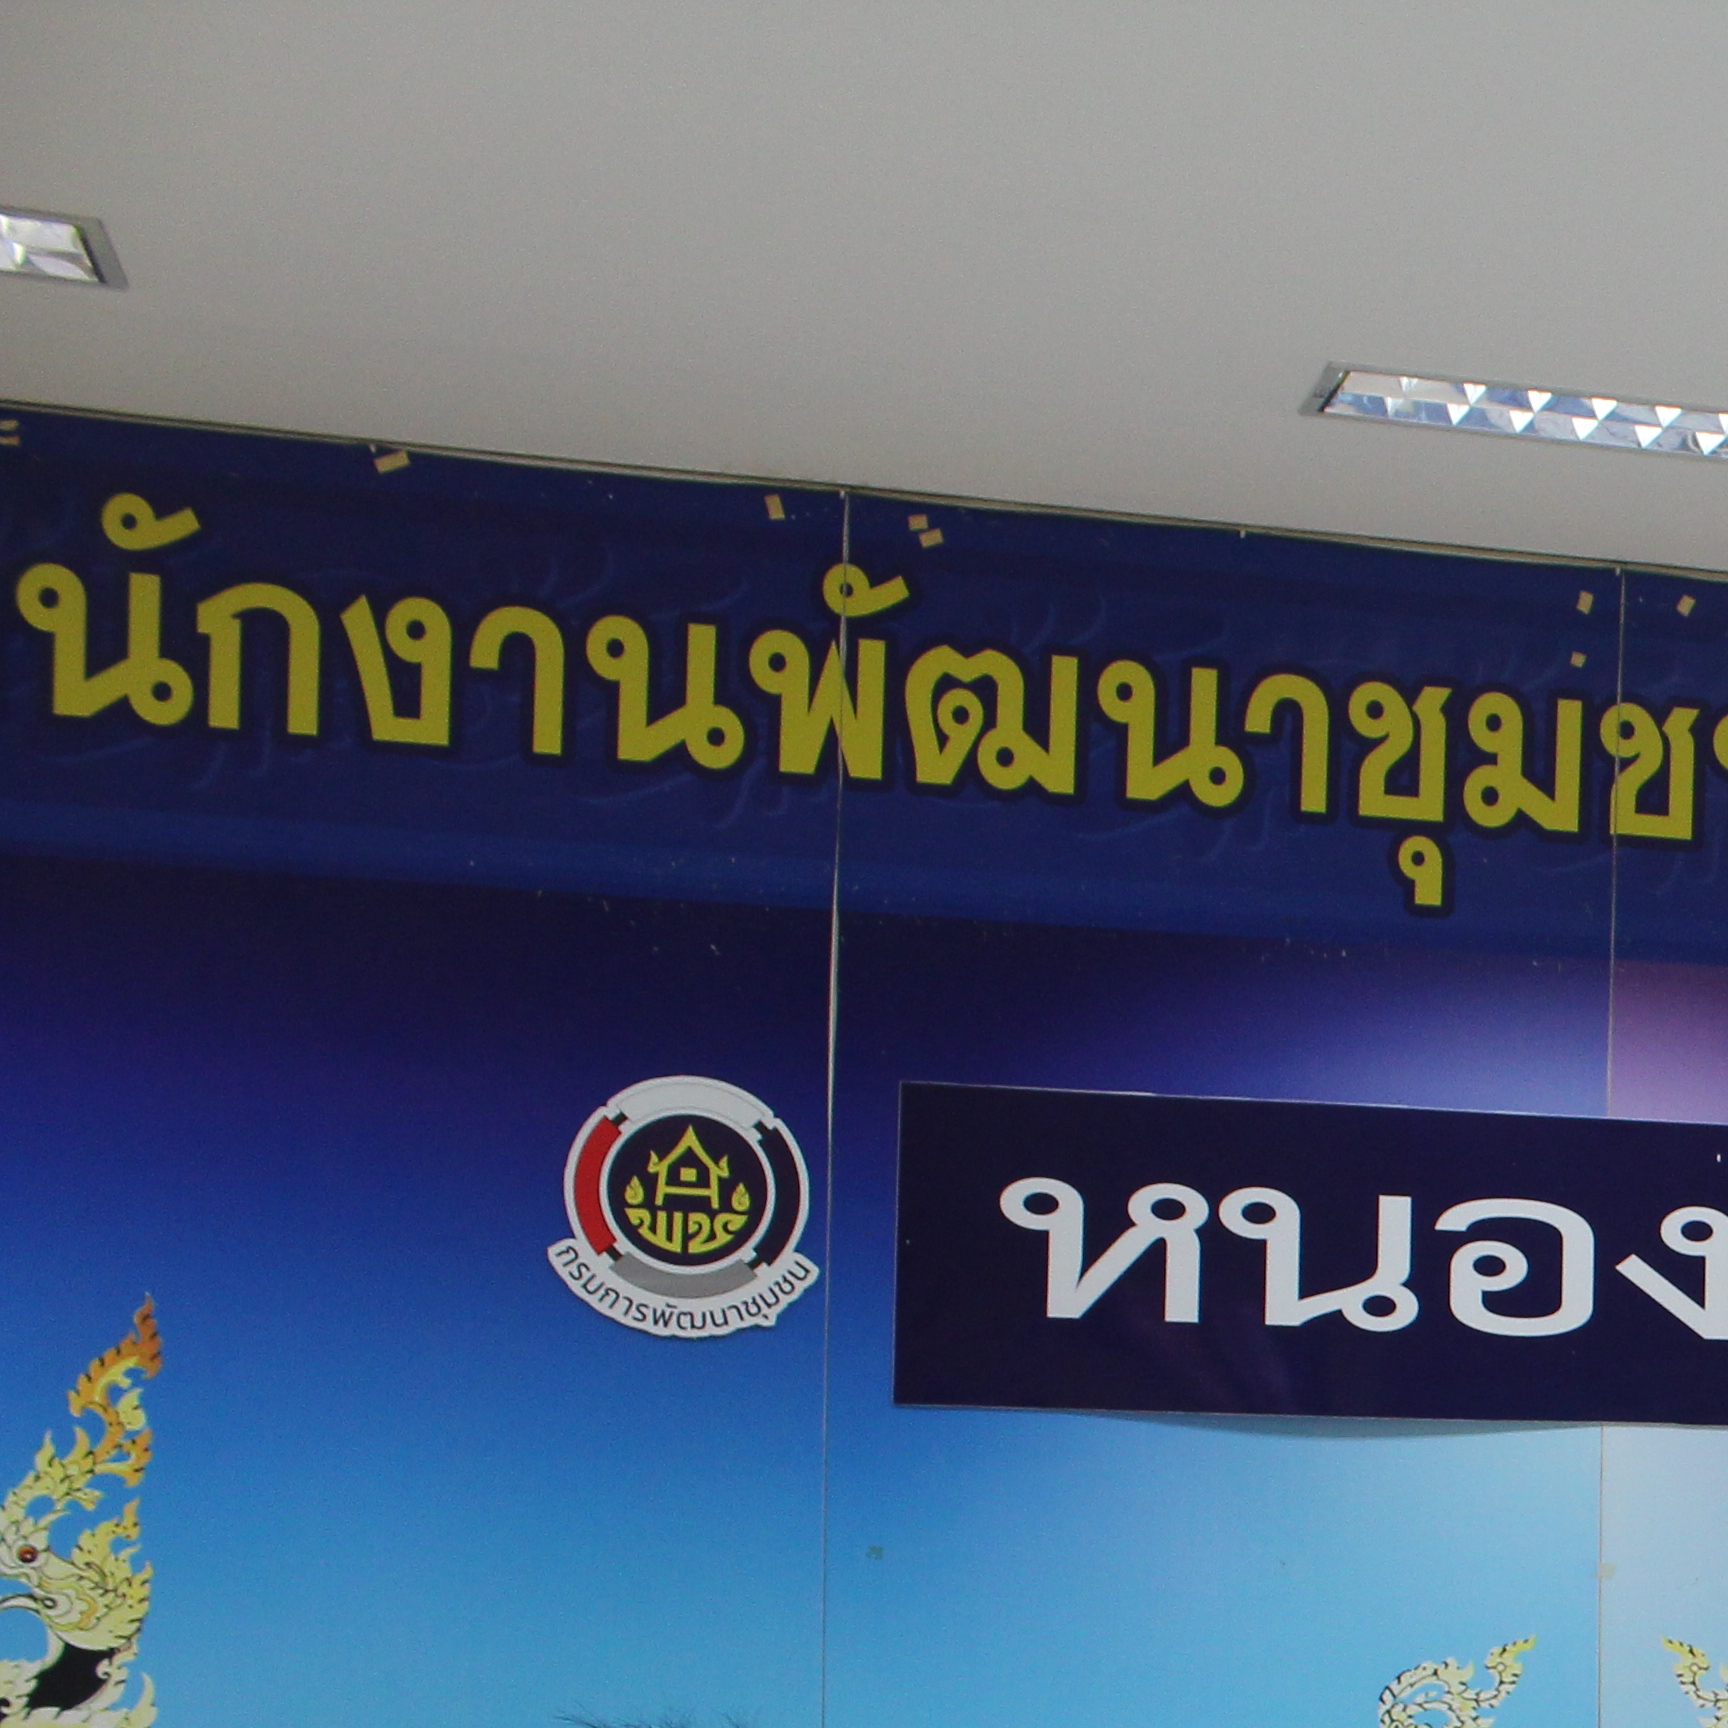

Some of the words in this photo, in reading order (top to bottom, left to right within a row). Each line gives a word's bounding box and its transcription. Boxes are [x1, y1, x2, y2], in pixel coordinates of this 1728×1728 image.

[555, 1244, 812, 1331] กรมการพัฒนาชุมชน
